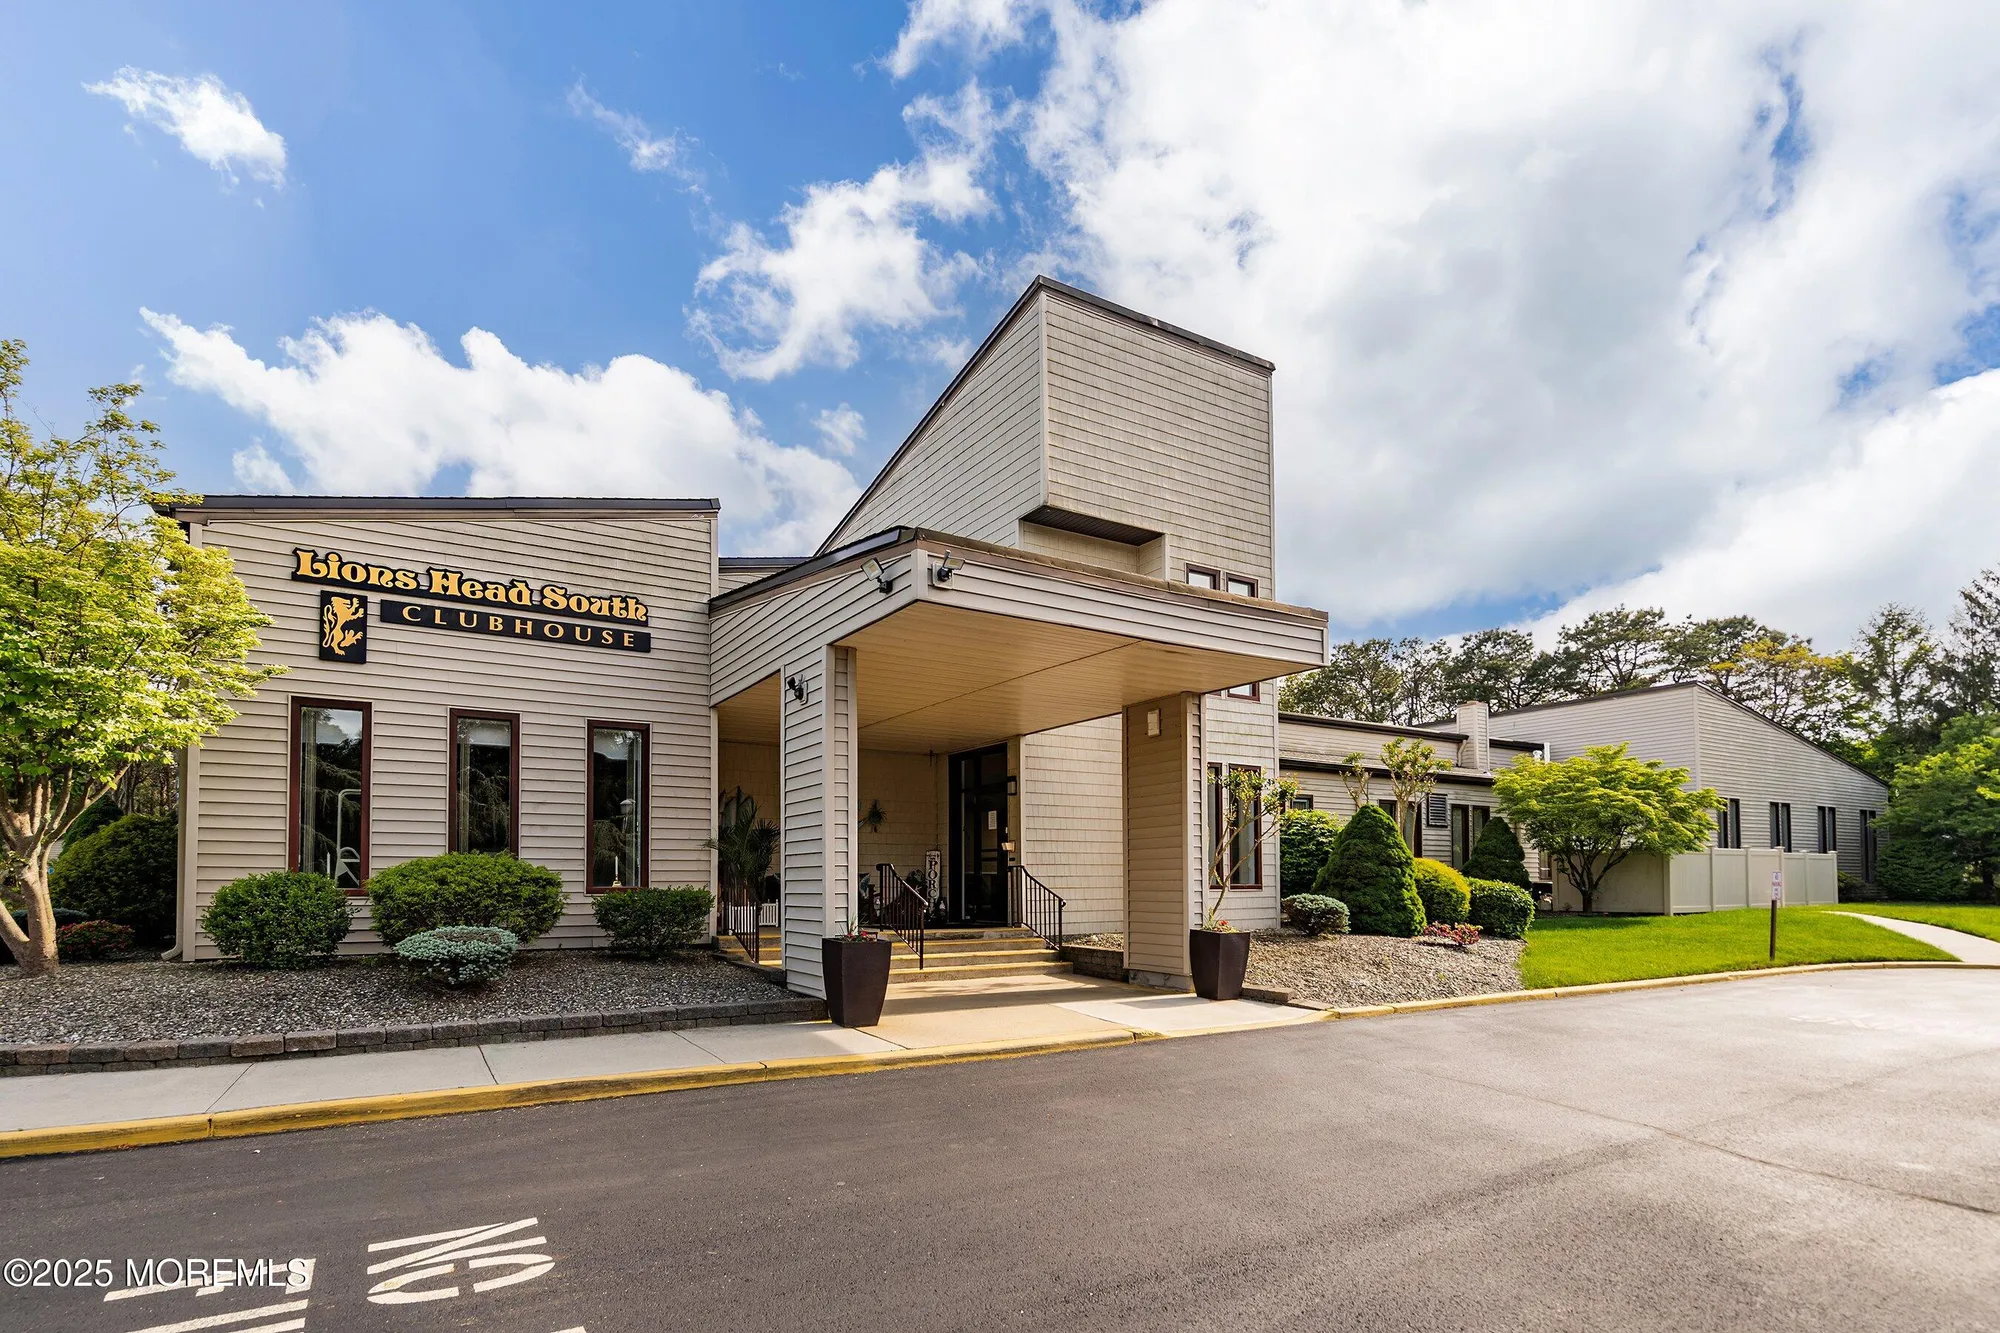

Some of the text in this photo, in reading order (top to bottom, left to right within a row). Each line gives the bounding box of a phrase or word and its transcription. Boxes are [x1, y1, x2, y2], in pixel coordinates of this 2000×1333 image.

[296, 550, 647, 622] Lions Head South
[402, 606, 635, 647] CLUBHOUSE
